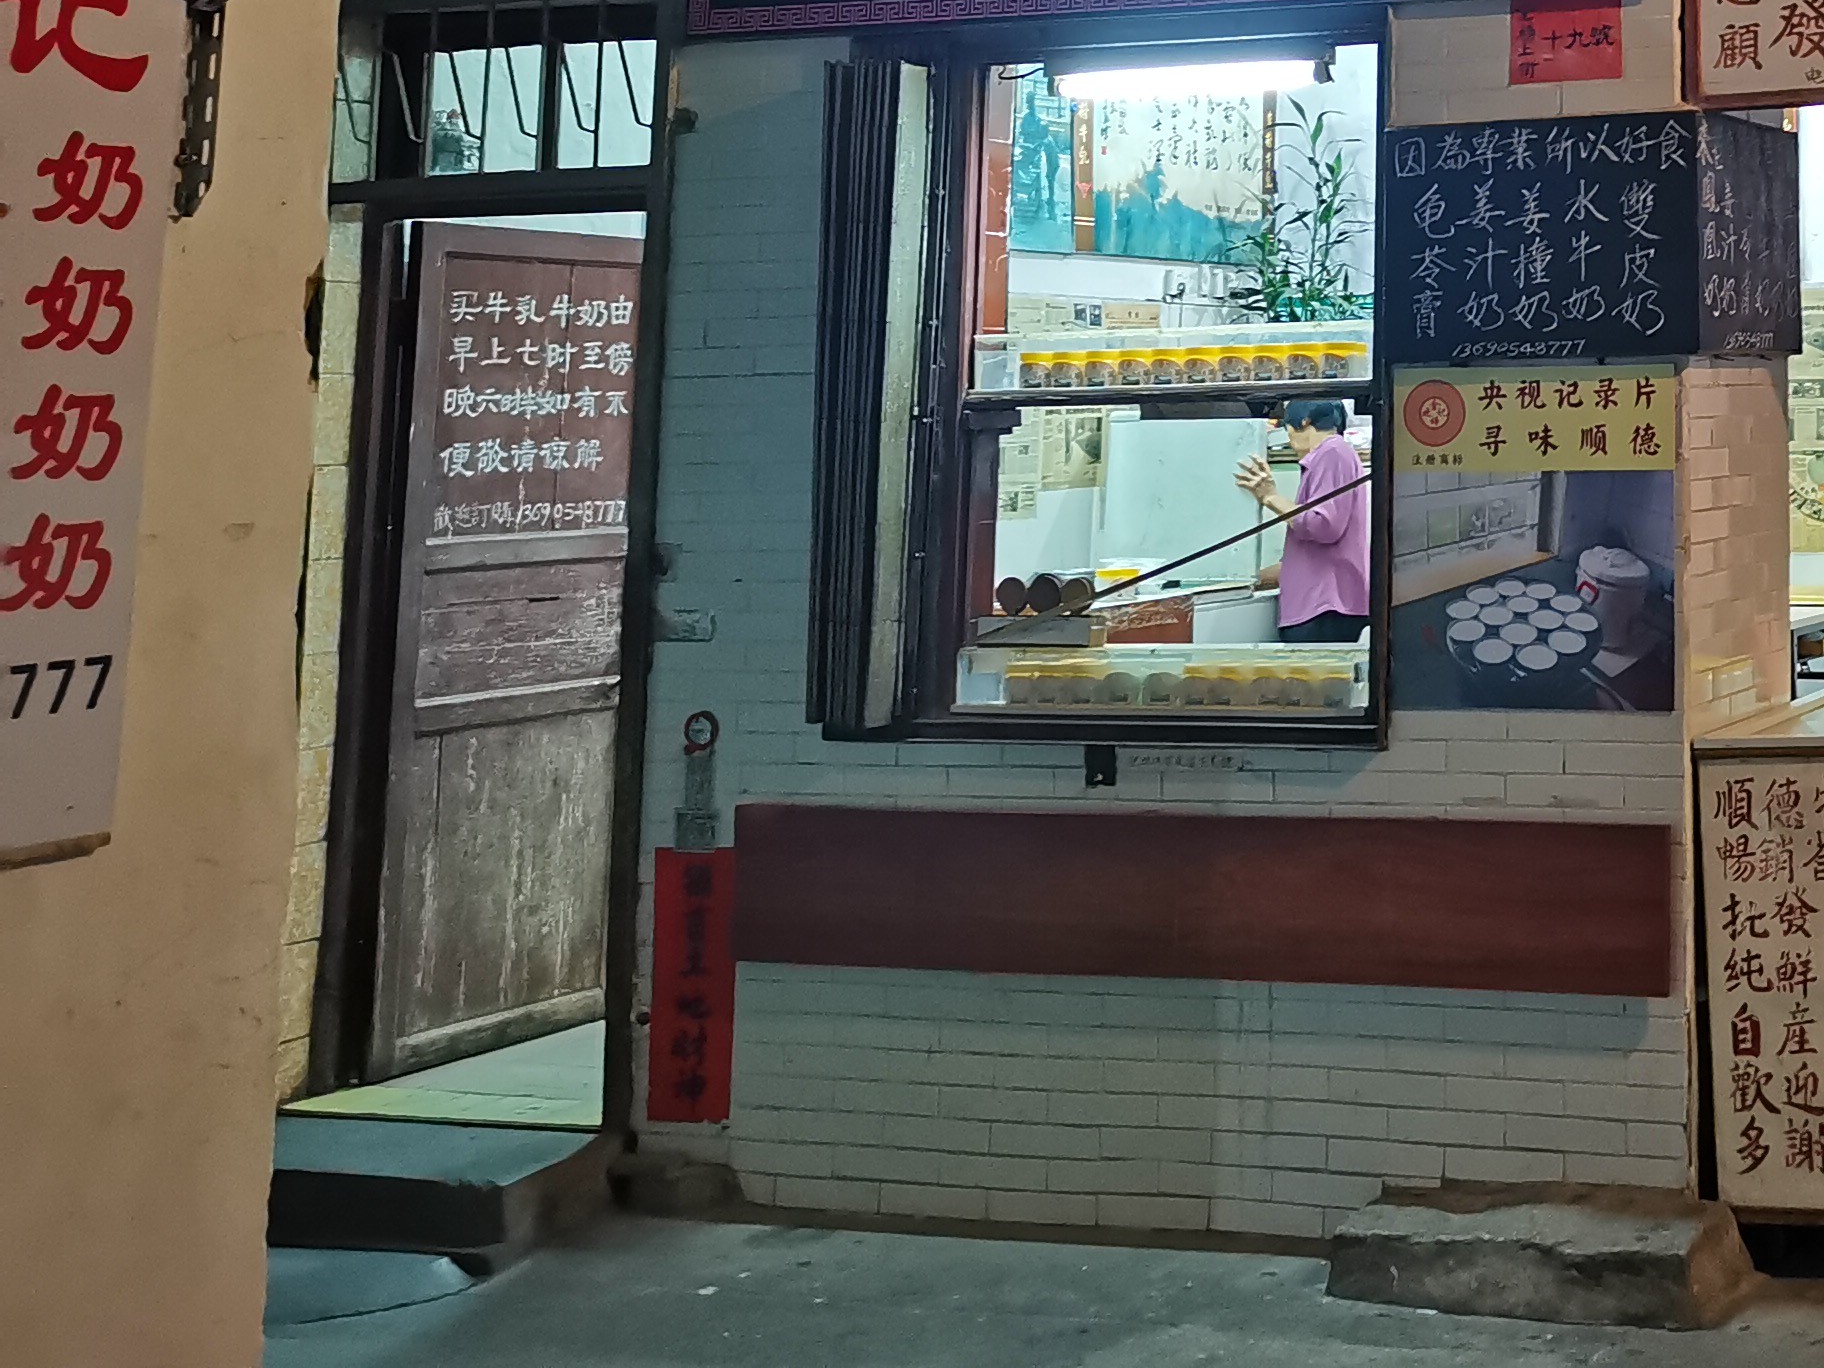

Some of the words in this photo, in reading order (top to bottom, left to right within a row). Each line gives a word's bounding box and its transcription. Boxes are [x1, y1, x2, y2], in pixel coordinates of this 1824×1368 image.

[1452, 339, 1585, 357] 13690548777
[1477, 378, 1661, 412] 央视记录片
[1478, 423, 1662, 458] 寻味顺德
[8, 654, 114, 721] 777
